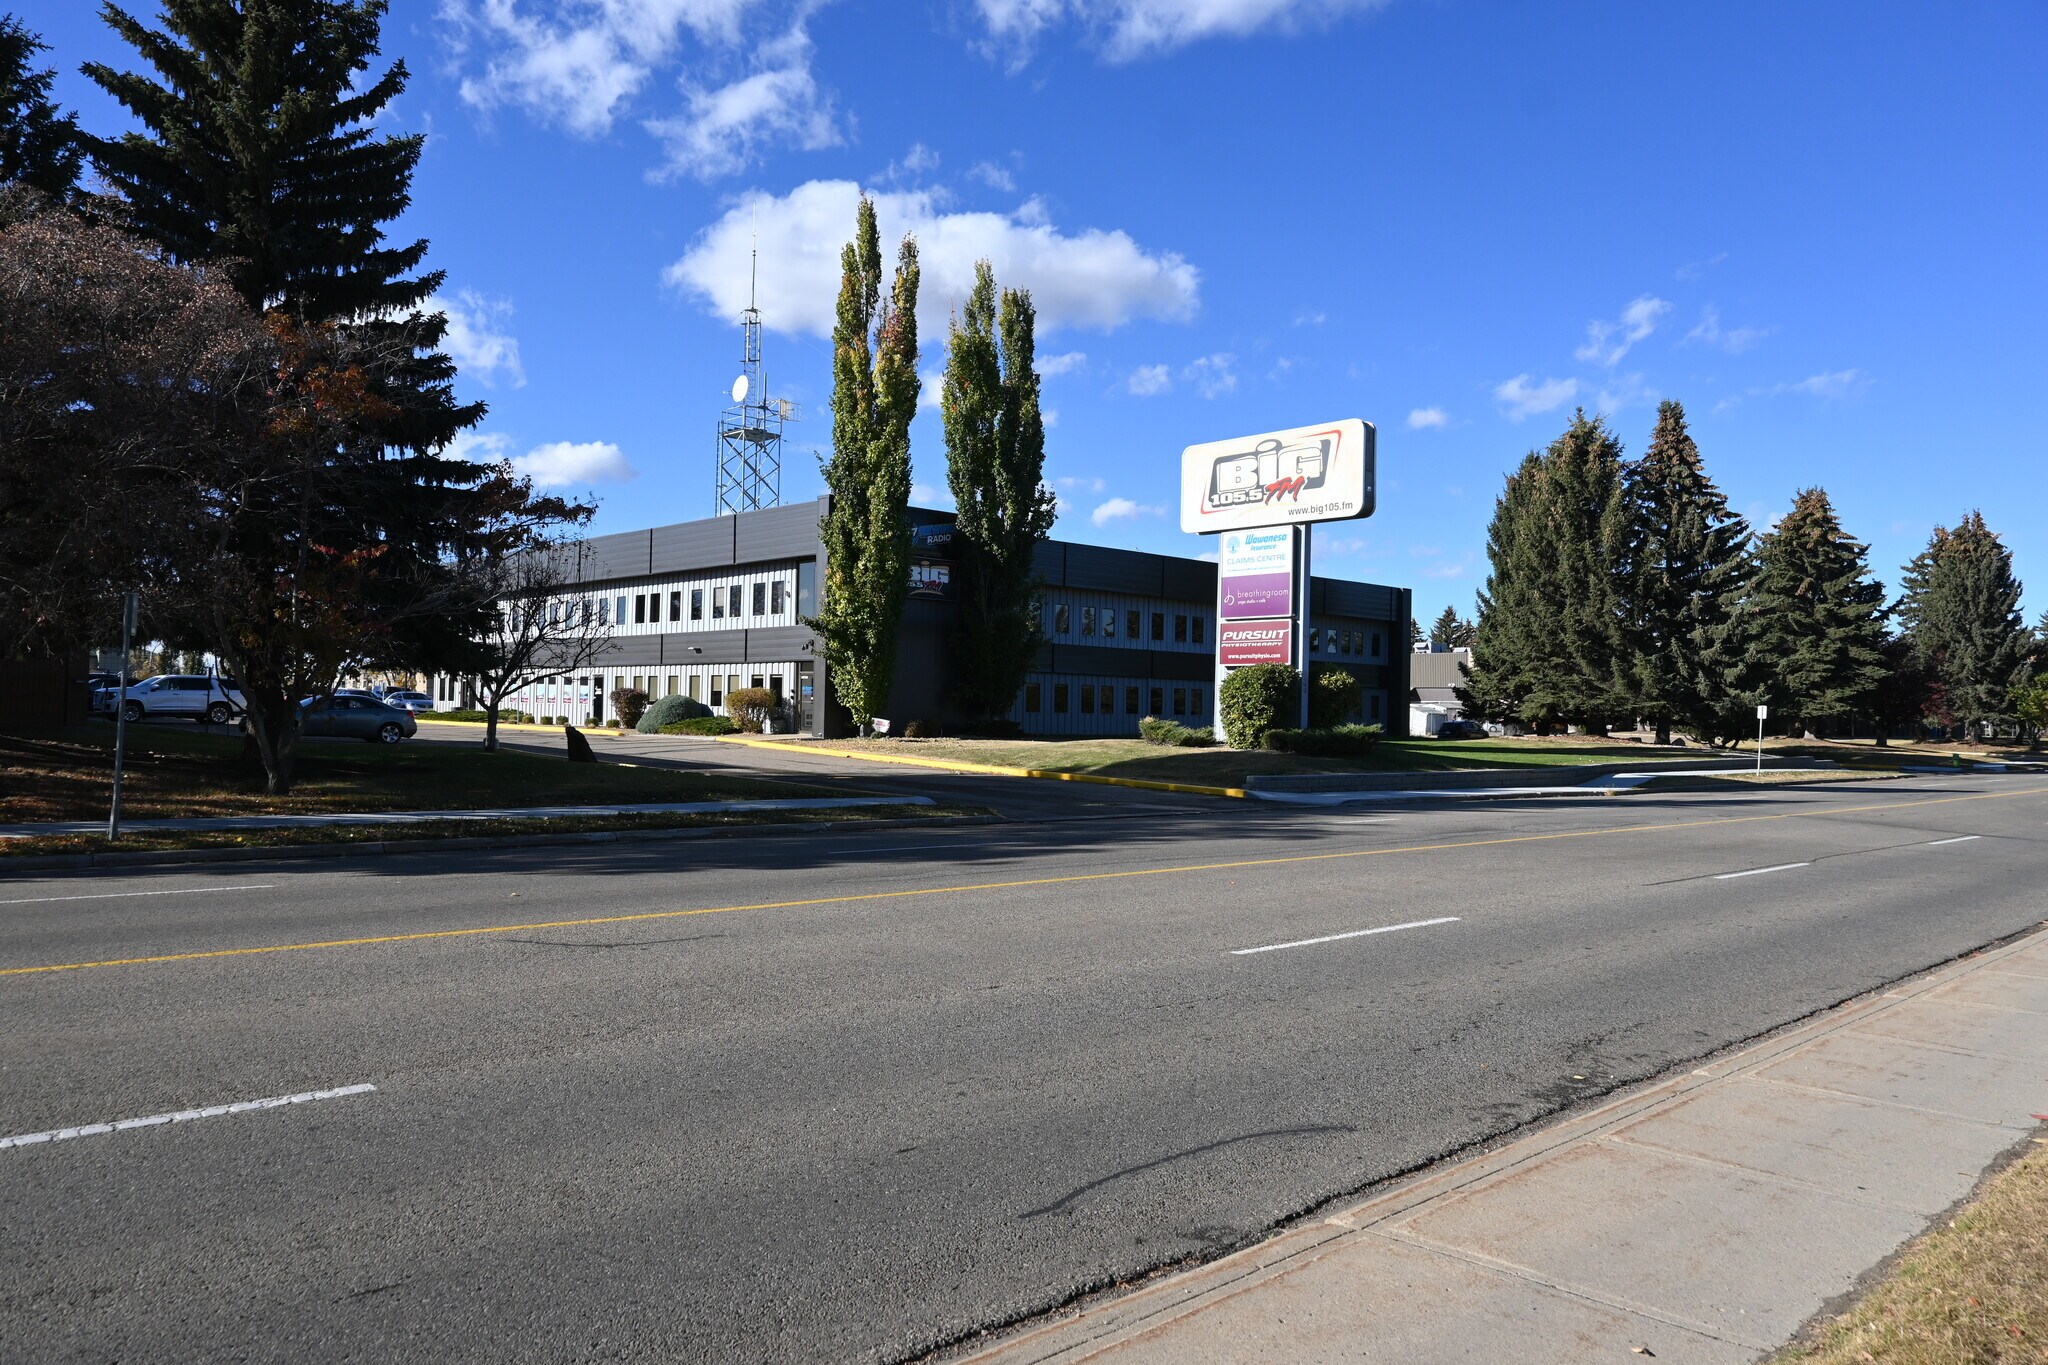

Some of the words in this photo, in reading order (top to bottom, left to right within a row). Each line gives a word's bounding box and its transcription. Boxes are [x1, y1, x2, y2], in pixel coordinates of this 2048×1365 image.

[1211, 488, 1264, 508] 105.5
[1264, 476, 1305, 505] FM
[1288, 501, 1354, 516] www.big105.fm
[927, 534, 951, 544] RADIO
[1245, 534, 1287, 545] Wawanesa
[1226, 557, 1255, 565] CLAIMS
[1256, 554, 1287, 563] CENTRE
[1222, 629, 1289, 641] PURSUIT
